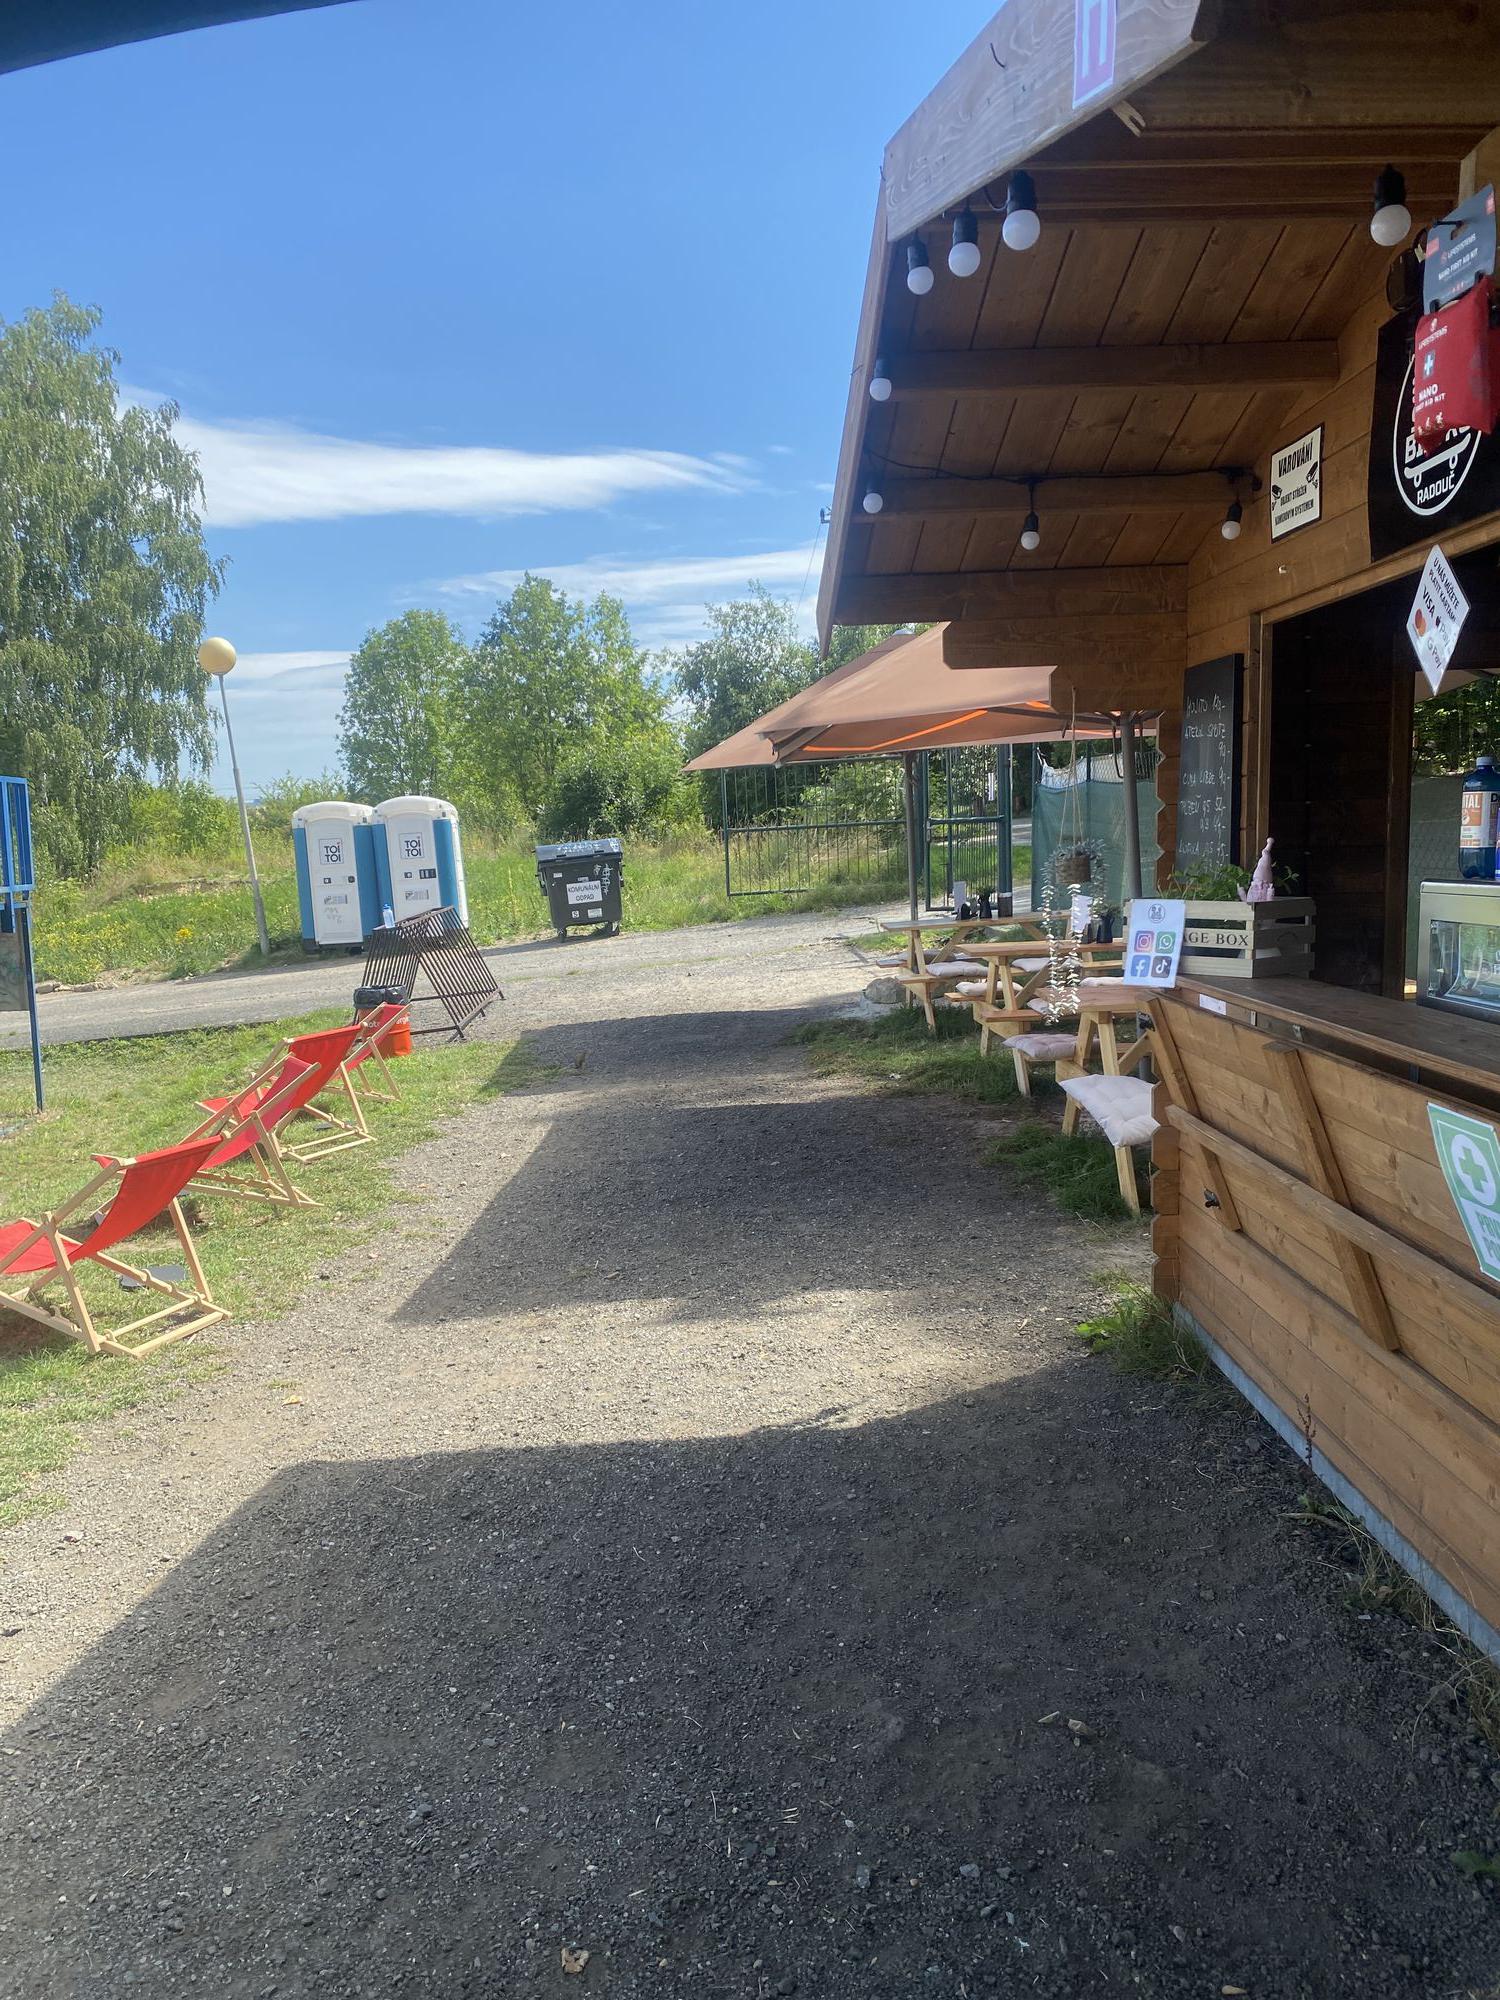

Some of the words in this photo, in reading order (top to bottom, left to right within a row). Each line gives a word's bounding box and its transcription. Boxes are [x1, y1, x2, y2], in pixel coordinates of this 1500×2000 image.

[1418, 383, 1438, 401] NANO
[1278, 437, 1314, 478] VAROVÁNÍ
[1416, 469, 1455, 505] RADOUČ
[1423, 585, 1436, 618] VISA
[1215, 933, 1250, 947] BOX
